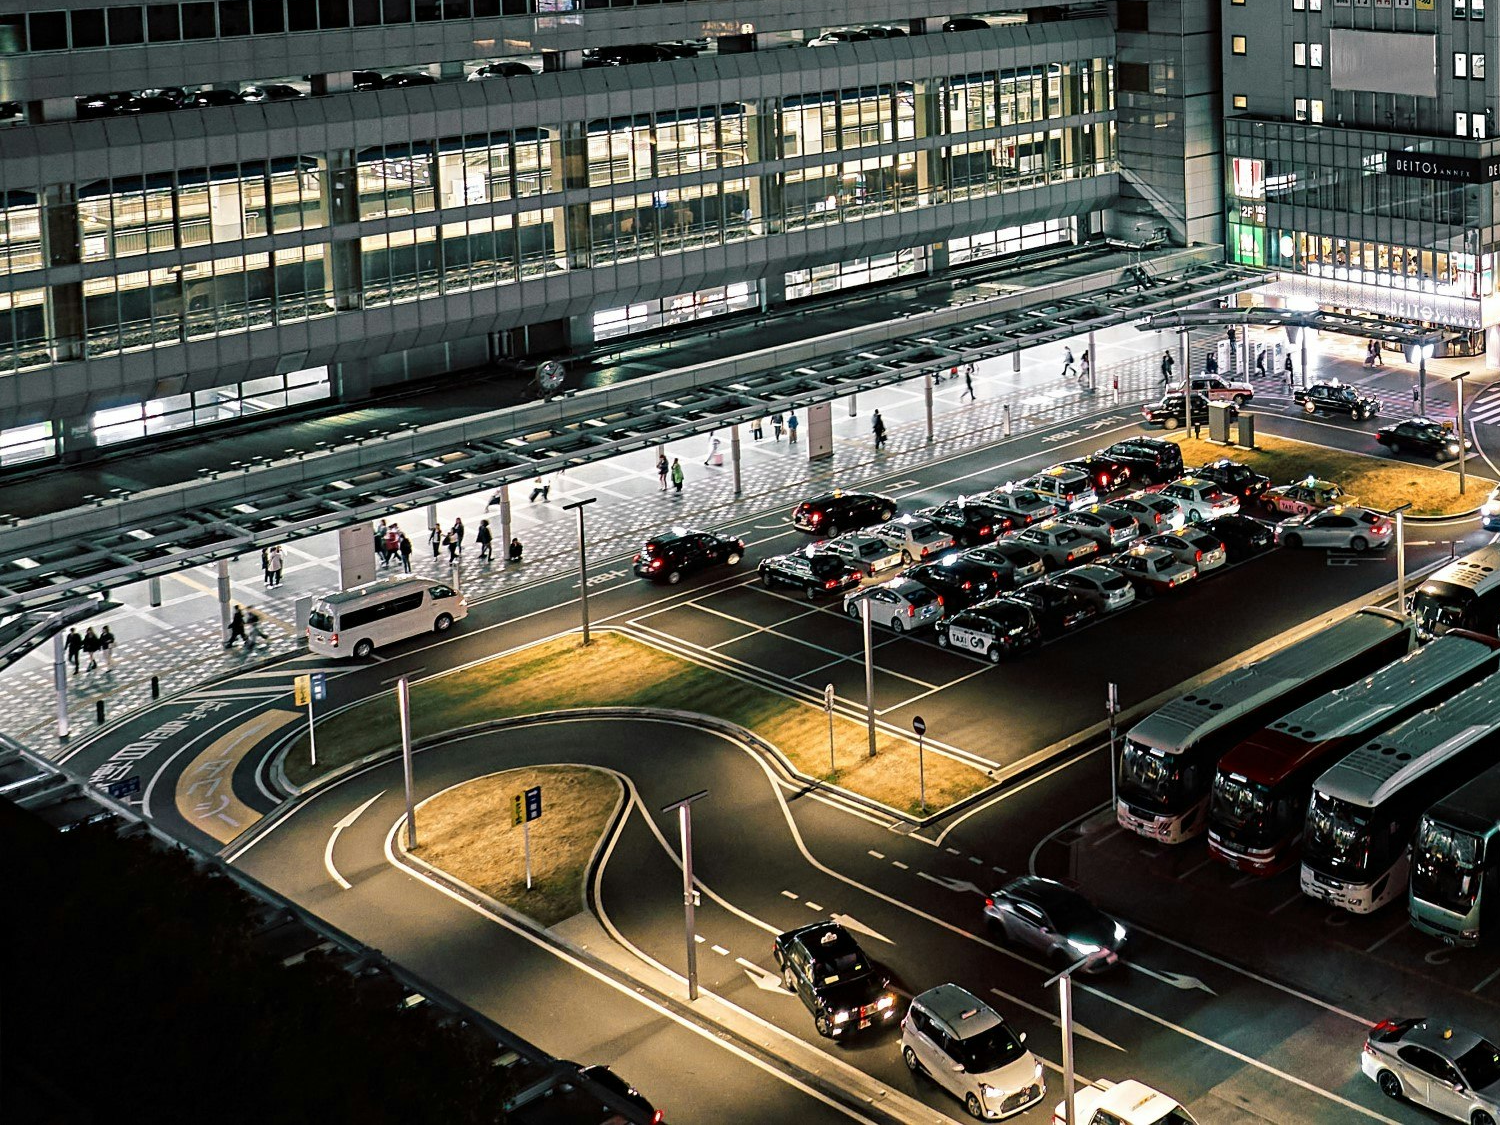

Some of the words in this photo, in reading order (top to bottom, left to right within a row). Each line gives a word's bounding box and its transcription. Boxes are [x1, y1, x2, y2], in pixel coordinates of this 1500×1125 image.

[1396, 159, 1438, 174] DEITOS
[1391, 301, 1441, 322] DEITOS
[1282, 503, 1294, 511] TAXI
[952, 633, 967, 644] TAXI
[88, 700, 232, 793] 緊急自動
